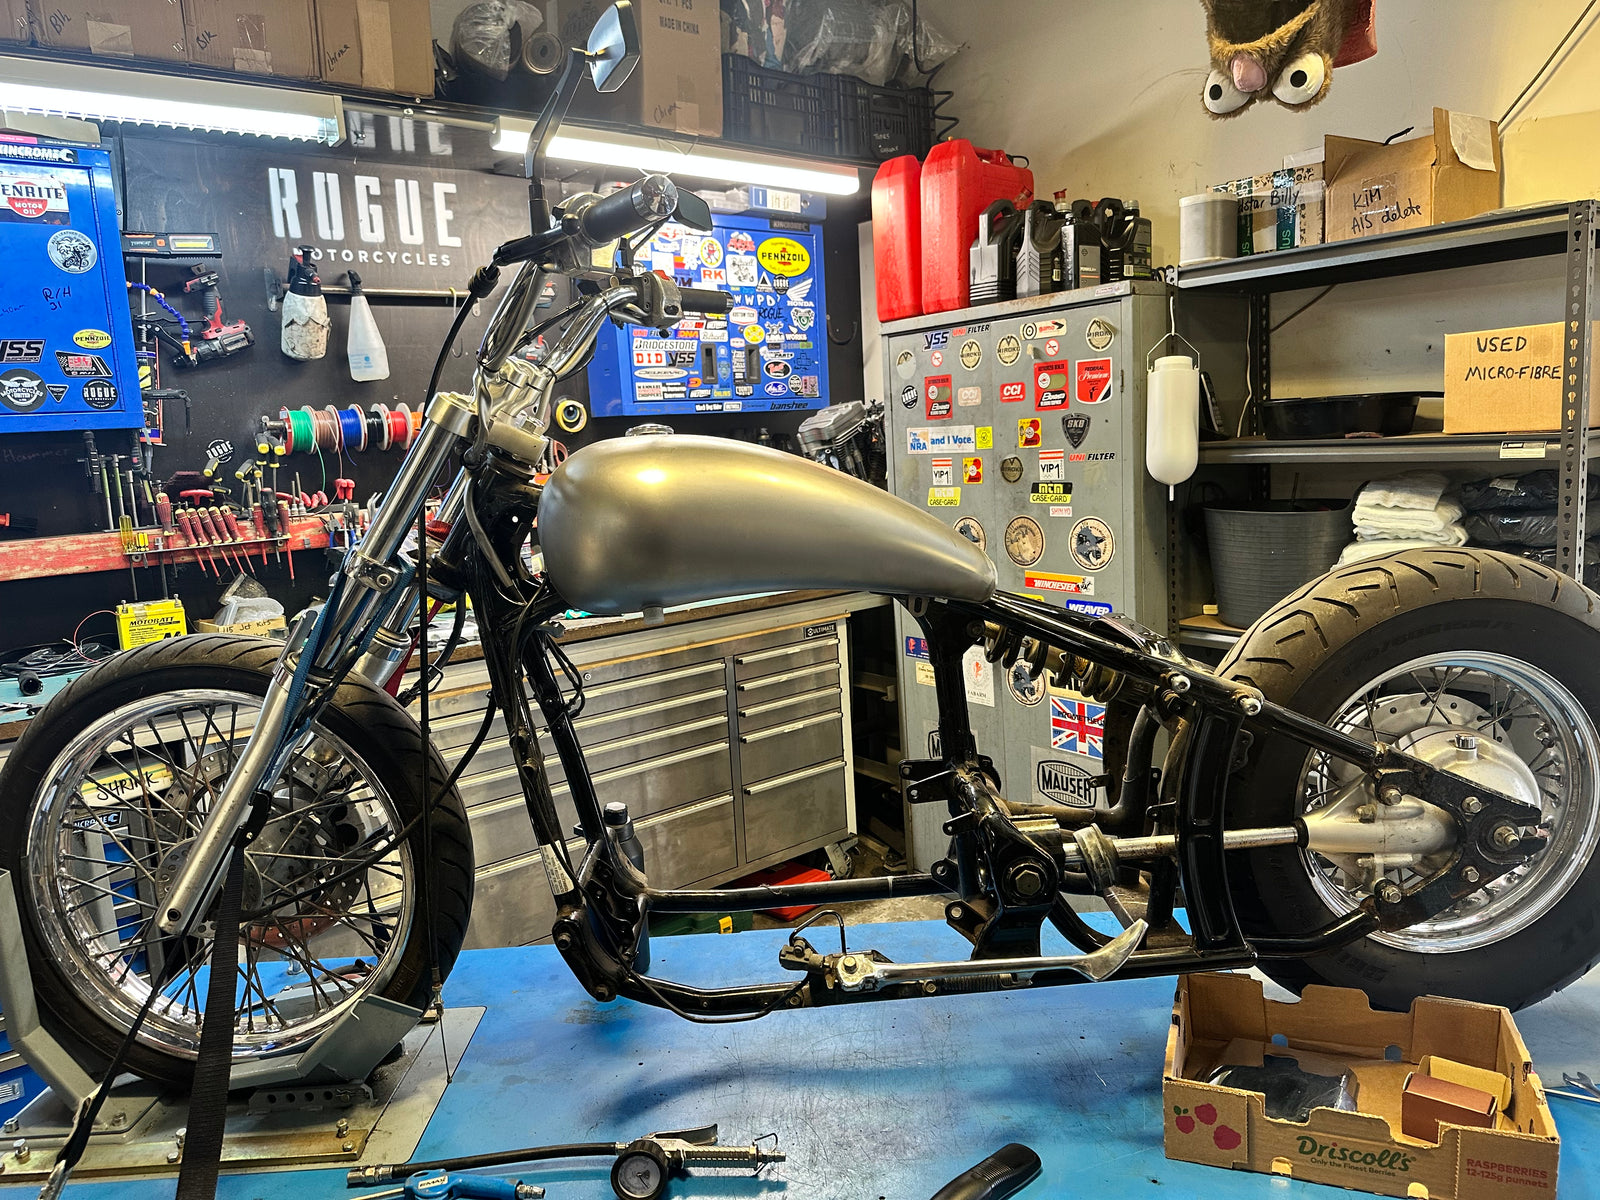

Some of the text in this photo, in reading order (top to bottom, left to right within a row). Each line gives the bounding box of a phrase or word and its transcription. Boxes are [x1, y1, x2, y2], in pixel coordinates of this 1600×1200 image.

[659, 16, 675, 30] MADE
[682, 21, 699, 35] CHINA
[0, 183, 64, 200] ENRITE
[1270, 187, 1300, 206] Billy
[14, 201, 43, 209] MOTOR
[22, 206, 37, 215] OIL
[268, 167, 463, 248] ROGUE
[1381, 198, 1423, 224] delete
[761, 251, 806, 262] PENNZOIL
[702, 269, 724, 280] RK
[42, 286, 71, 302] R/H
[50, 301, 62, 311] 31
[786, 299, 815, 308] HONDA
[758, 307, 784, 320] ROGUE
[633, 329, 648, 337] UNI
[952, 324, 990, 337] UNI FILTER
[75, 334, 111, 342] PENNZOIL
[635, 339, 696, 350] BRIDGESTONE
[923, 331, 950, 350] YSS
[1476, 336, 1527, 353] USED
[1464, 365, 1562, 381] MICRO-FIBRE
[83, 387, 118, 398] ROGUE
[961, 390, 978, 400] CCI
[1003, 384, 1022, 396] CCI
[769, 402, 809, 410] banshee
[910, 442, 928, 451] NRA
[930, 436, 945, 445] and
[952, 435, 975, 444] Vote.
[206, 440, 234, 459] ROGUE
[1069, 452, 1116, 462] UNI FILTER
[1033, 579, 1076, 592] WINCHESTER
[1068, 603, 1110, 616] WEAVER
[129, 616, 175, 627] MOTOBATT
[813, 624, 835, 635] ULTIMATE
[1041, 765, 1092, 804] MAUSER
[1296, 1135, 1411, 1172] Driscoll's
[1310, 1157, 1397, 1177] Only the Finest Berries
[1466, 1158, 1548, 1179] RASPBERRIES
[1466, 1168, 1549, 1189] 12-125g punnets
